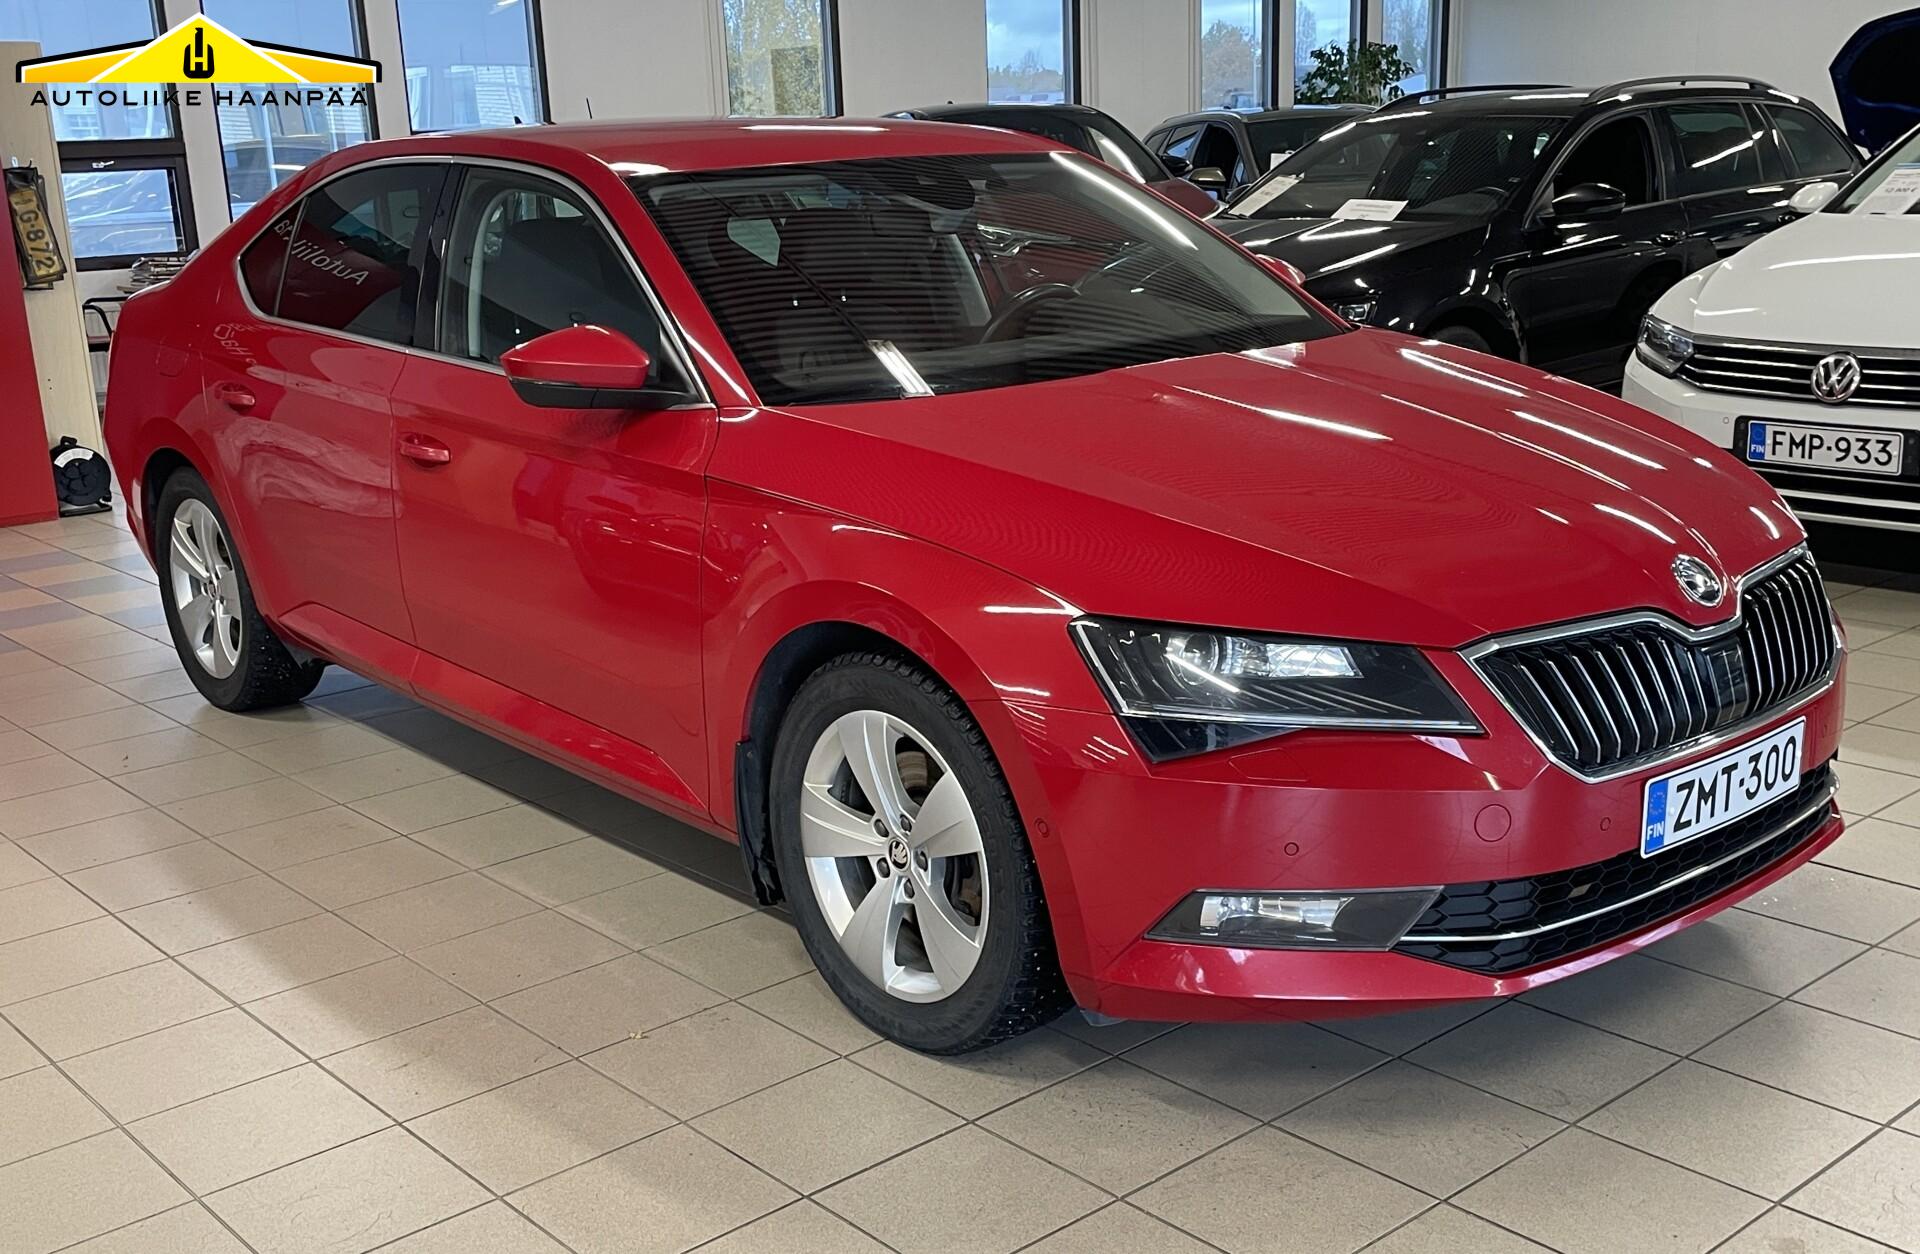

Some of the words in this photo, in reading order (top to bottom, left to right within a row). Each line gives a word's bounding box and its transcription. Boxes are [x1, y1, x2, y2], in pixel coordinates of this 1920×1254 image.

[1751, 443, 1765, 454] FIN
[1771, 430, 1893, 467] FMP-933
[1646, 821, 1665, 841] FIN
[1673, 735, 1797, 833] ZMT-300
